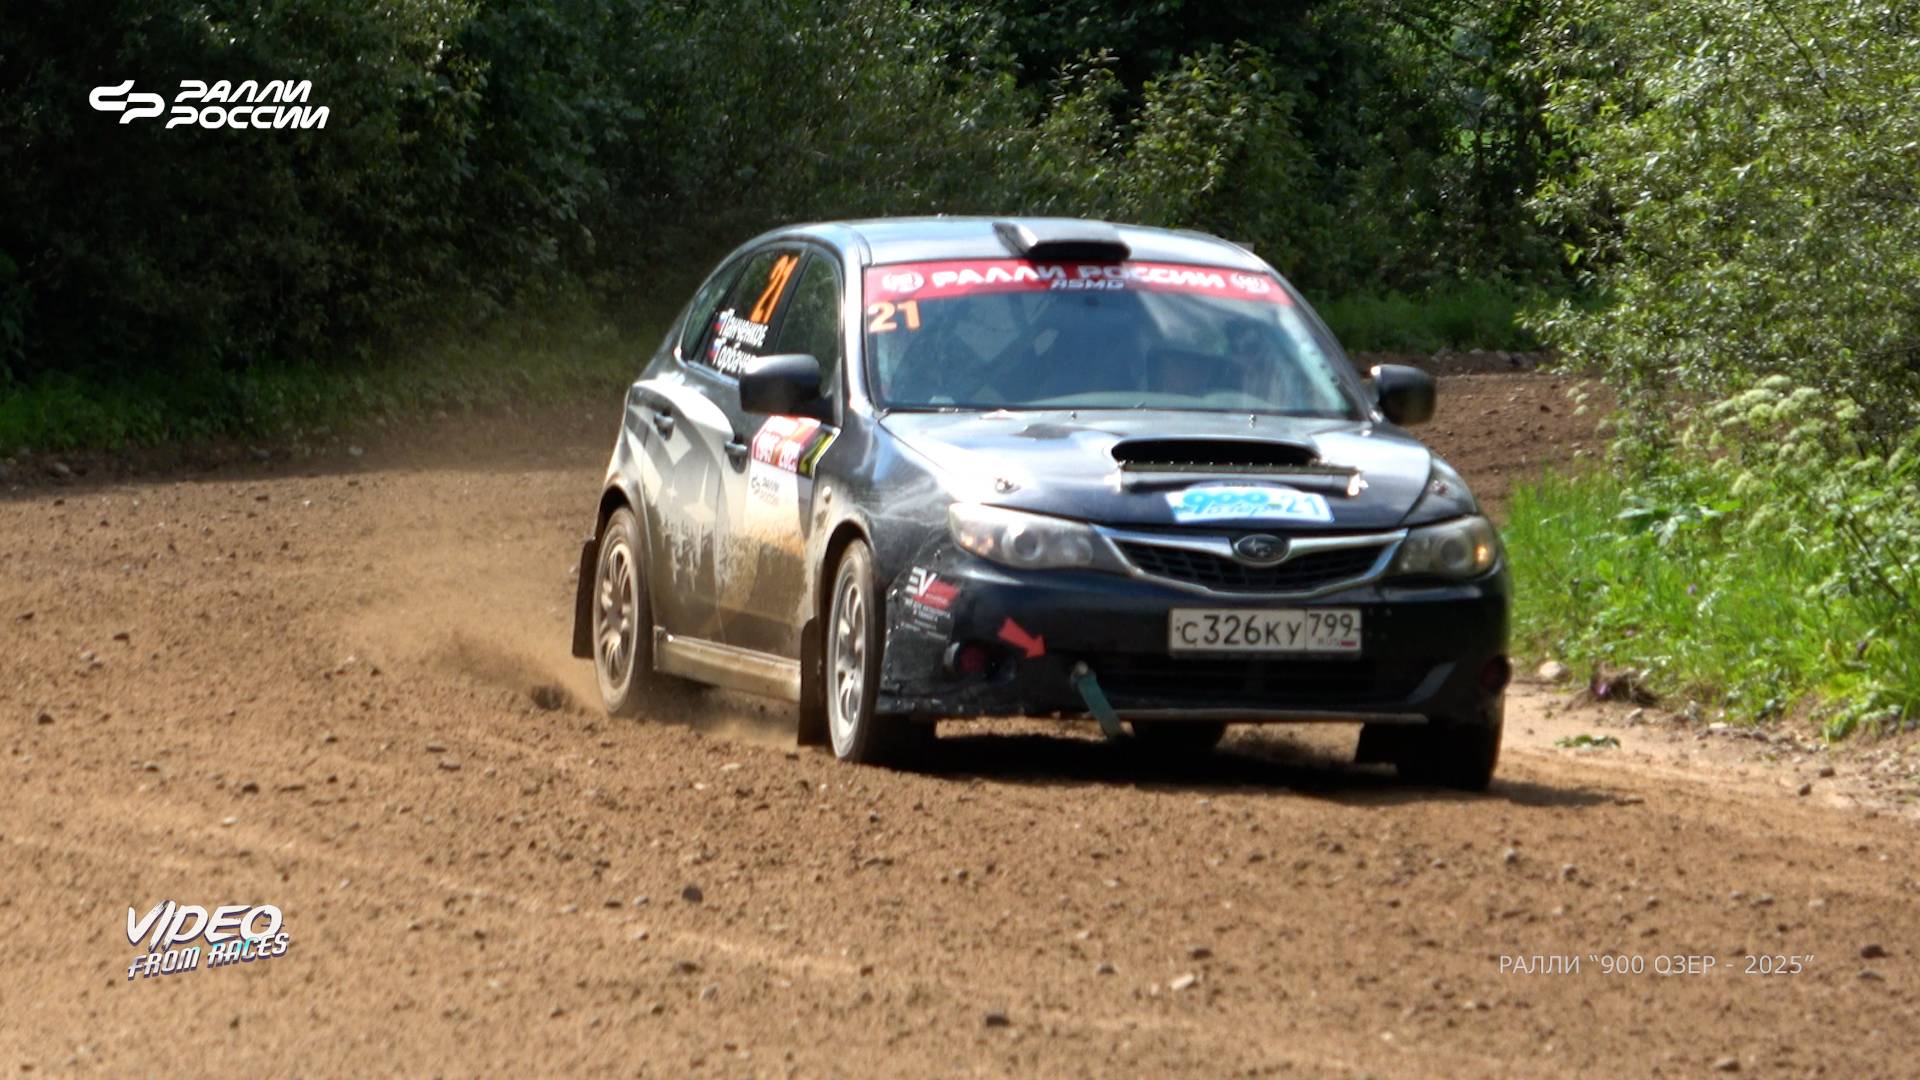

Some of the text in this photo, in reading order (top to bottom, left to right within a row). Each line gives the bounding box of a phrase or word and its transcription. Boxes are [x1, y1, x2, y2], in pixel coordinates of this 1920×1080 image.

[750, 254, 799, 325] 21
[931, 264, 1226, 289] РАЛЛИ РОССИИ
[866, 299, 921, 334] 21
[1309, 612, 1354, 638] 799
